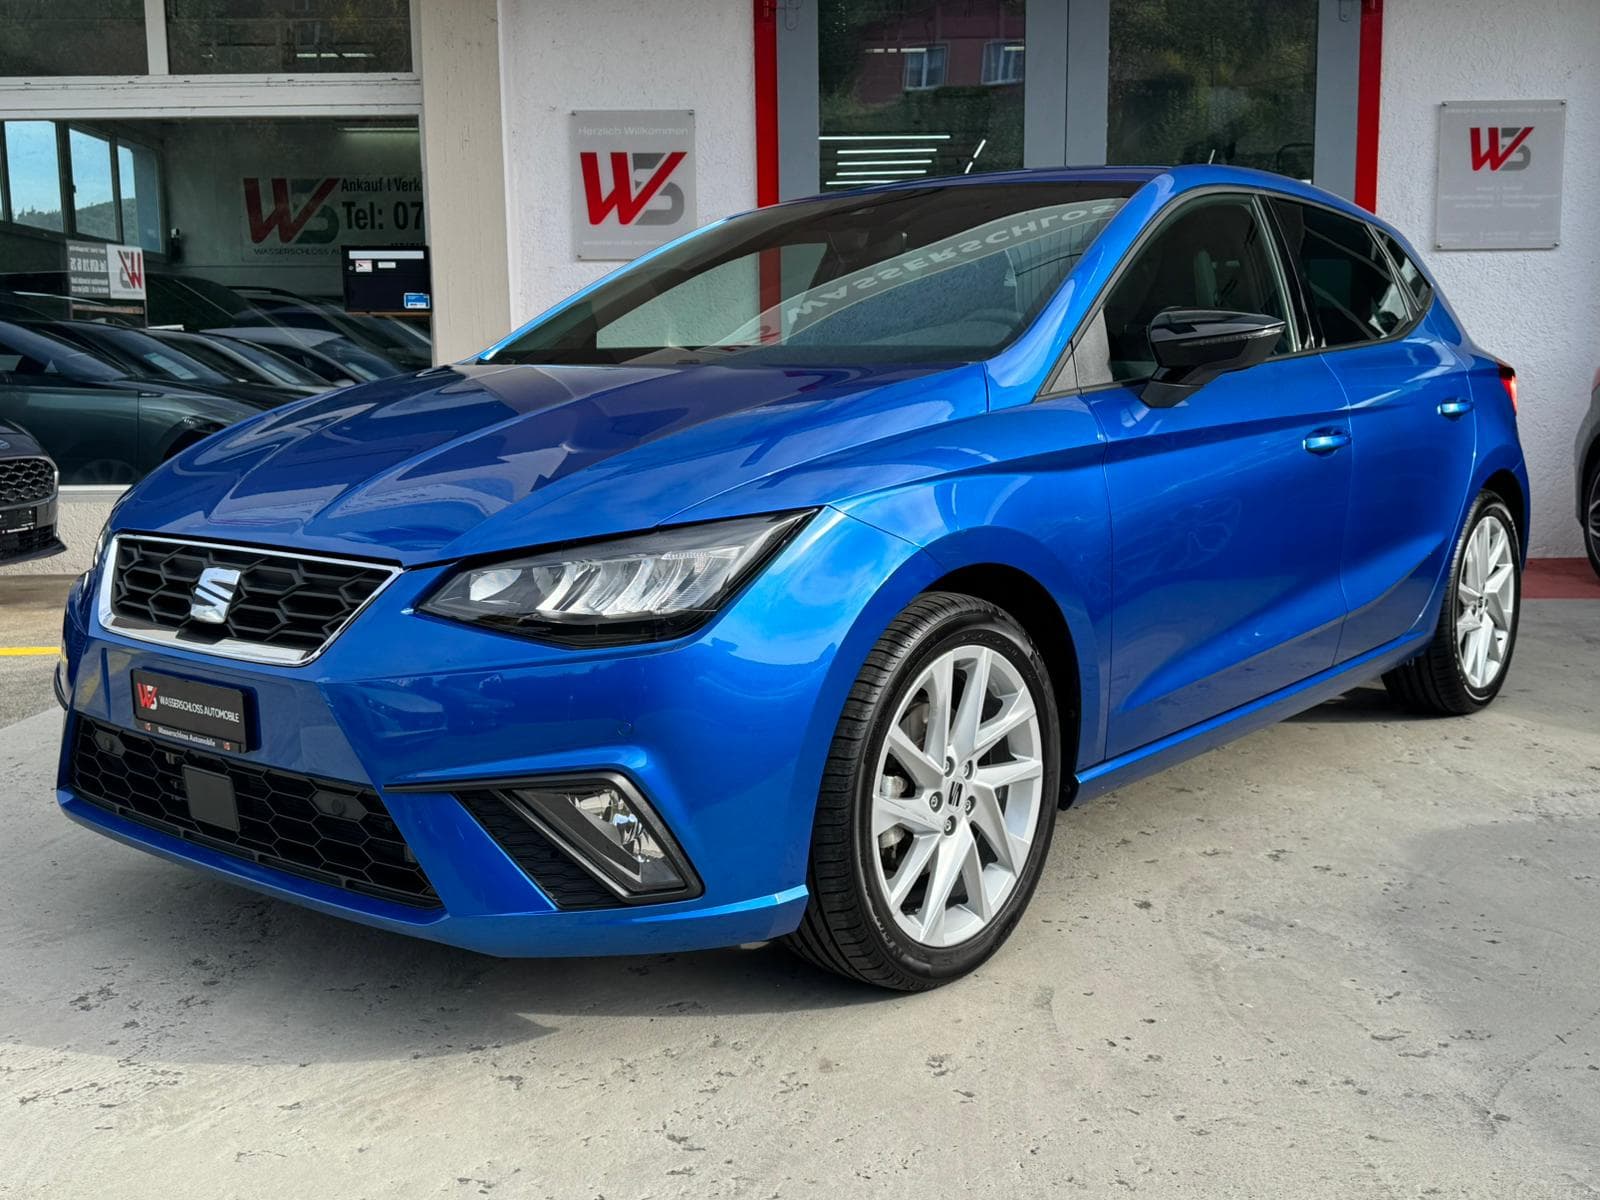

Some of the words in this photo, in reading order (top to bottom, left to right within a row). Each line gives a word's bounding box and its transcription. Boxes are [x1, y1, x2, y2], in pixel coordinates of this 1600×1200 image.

[579, 126, 621, 137] Herzlich
[622, 126, 689, 137] Willkommen
[341, 177, 383, 192] Ankauf
[341, 201, 384, 230] Tel:
[393, 201, 424, 230] 07
[159, 694, 204, 715] WASSERSCHLOSS
[204, 705, 240, 723] AUTOMOBILE
